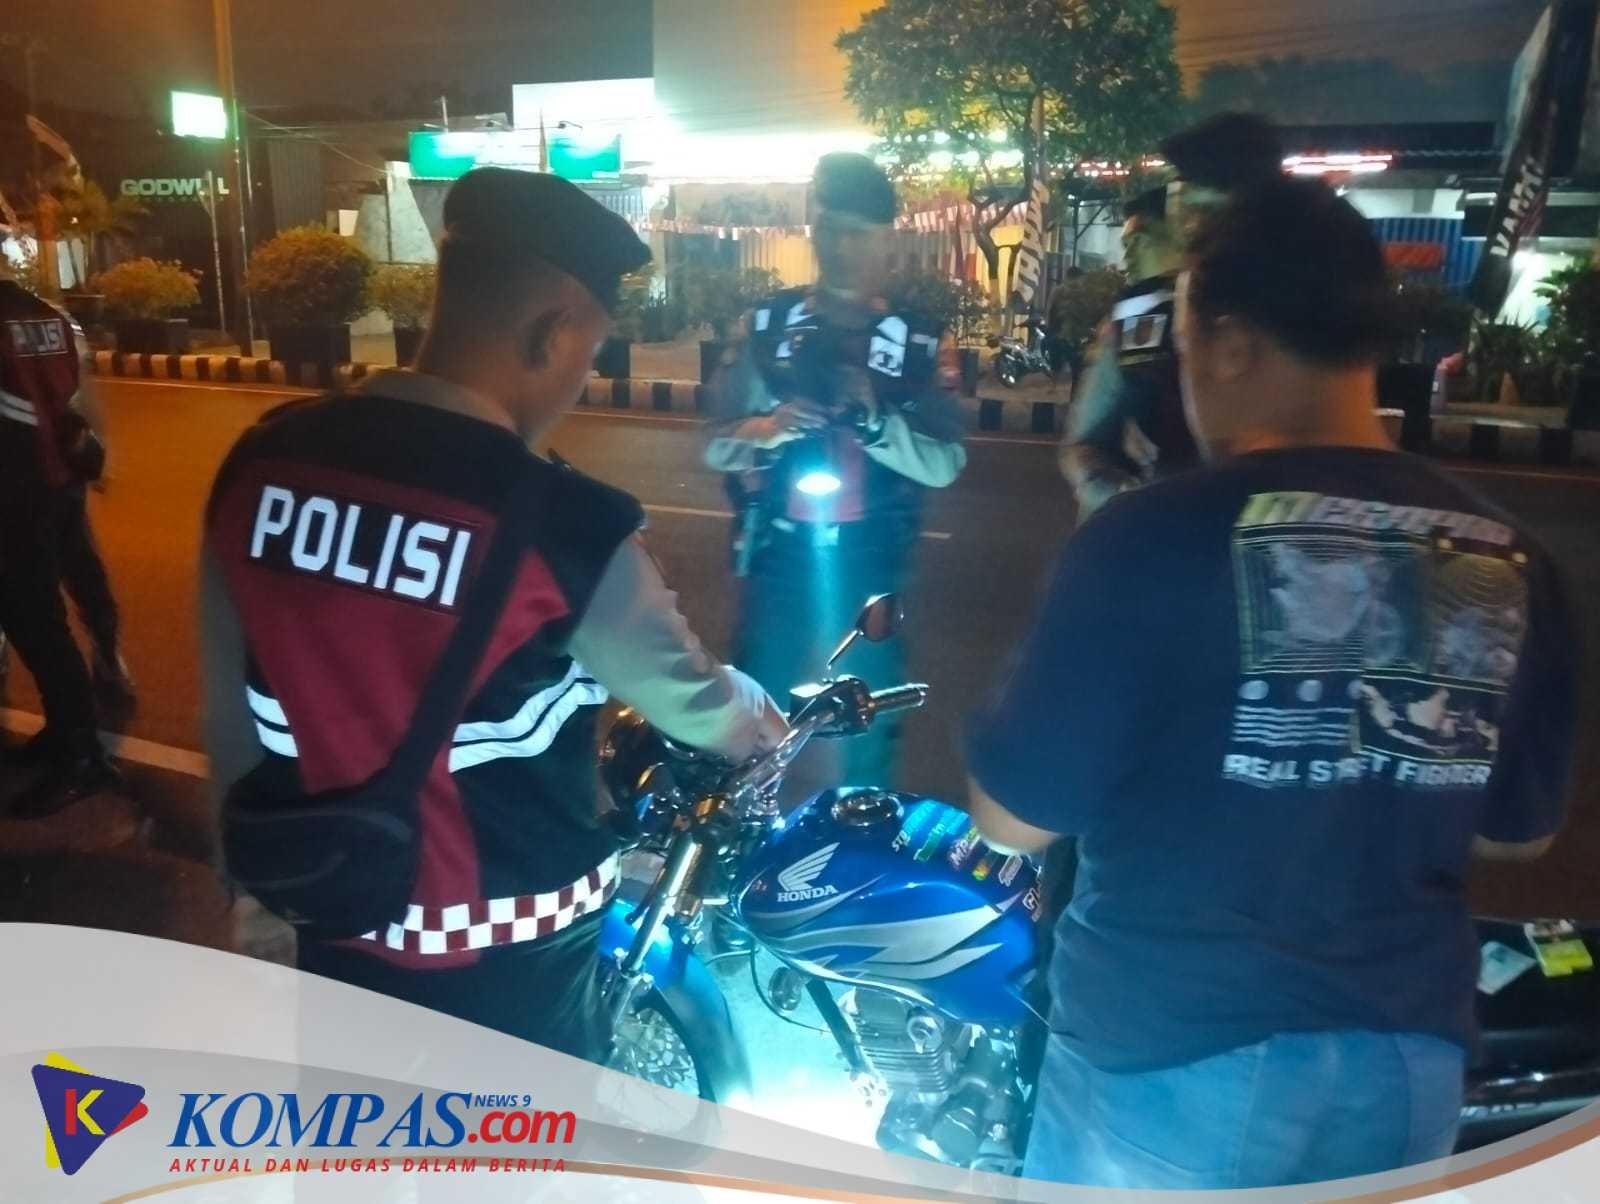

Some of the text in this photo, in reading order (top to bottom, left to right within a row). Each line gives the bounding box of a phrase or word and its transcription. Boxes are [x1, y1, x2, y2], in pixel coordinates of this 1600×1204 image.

[121, 177, 230, 196] GODWIL
[250, 485, 472, 607] POLISI
[777, 884, 840, 903] HONDA
